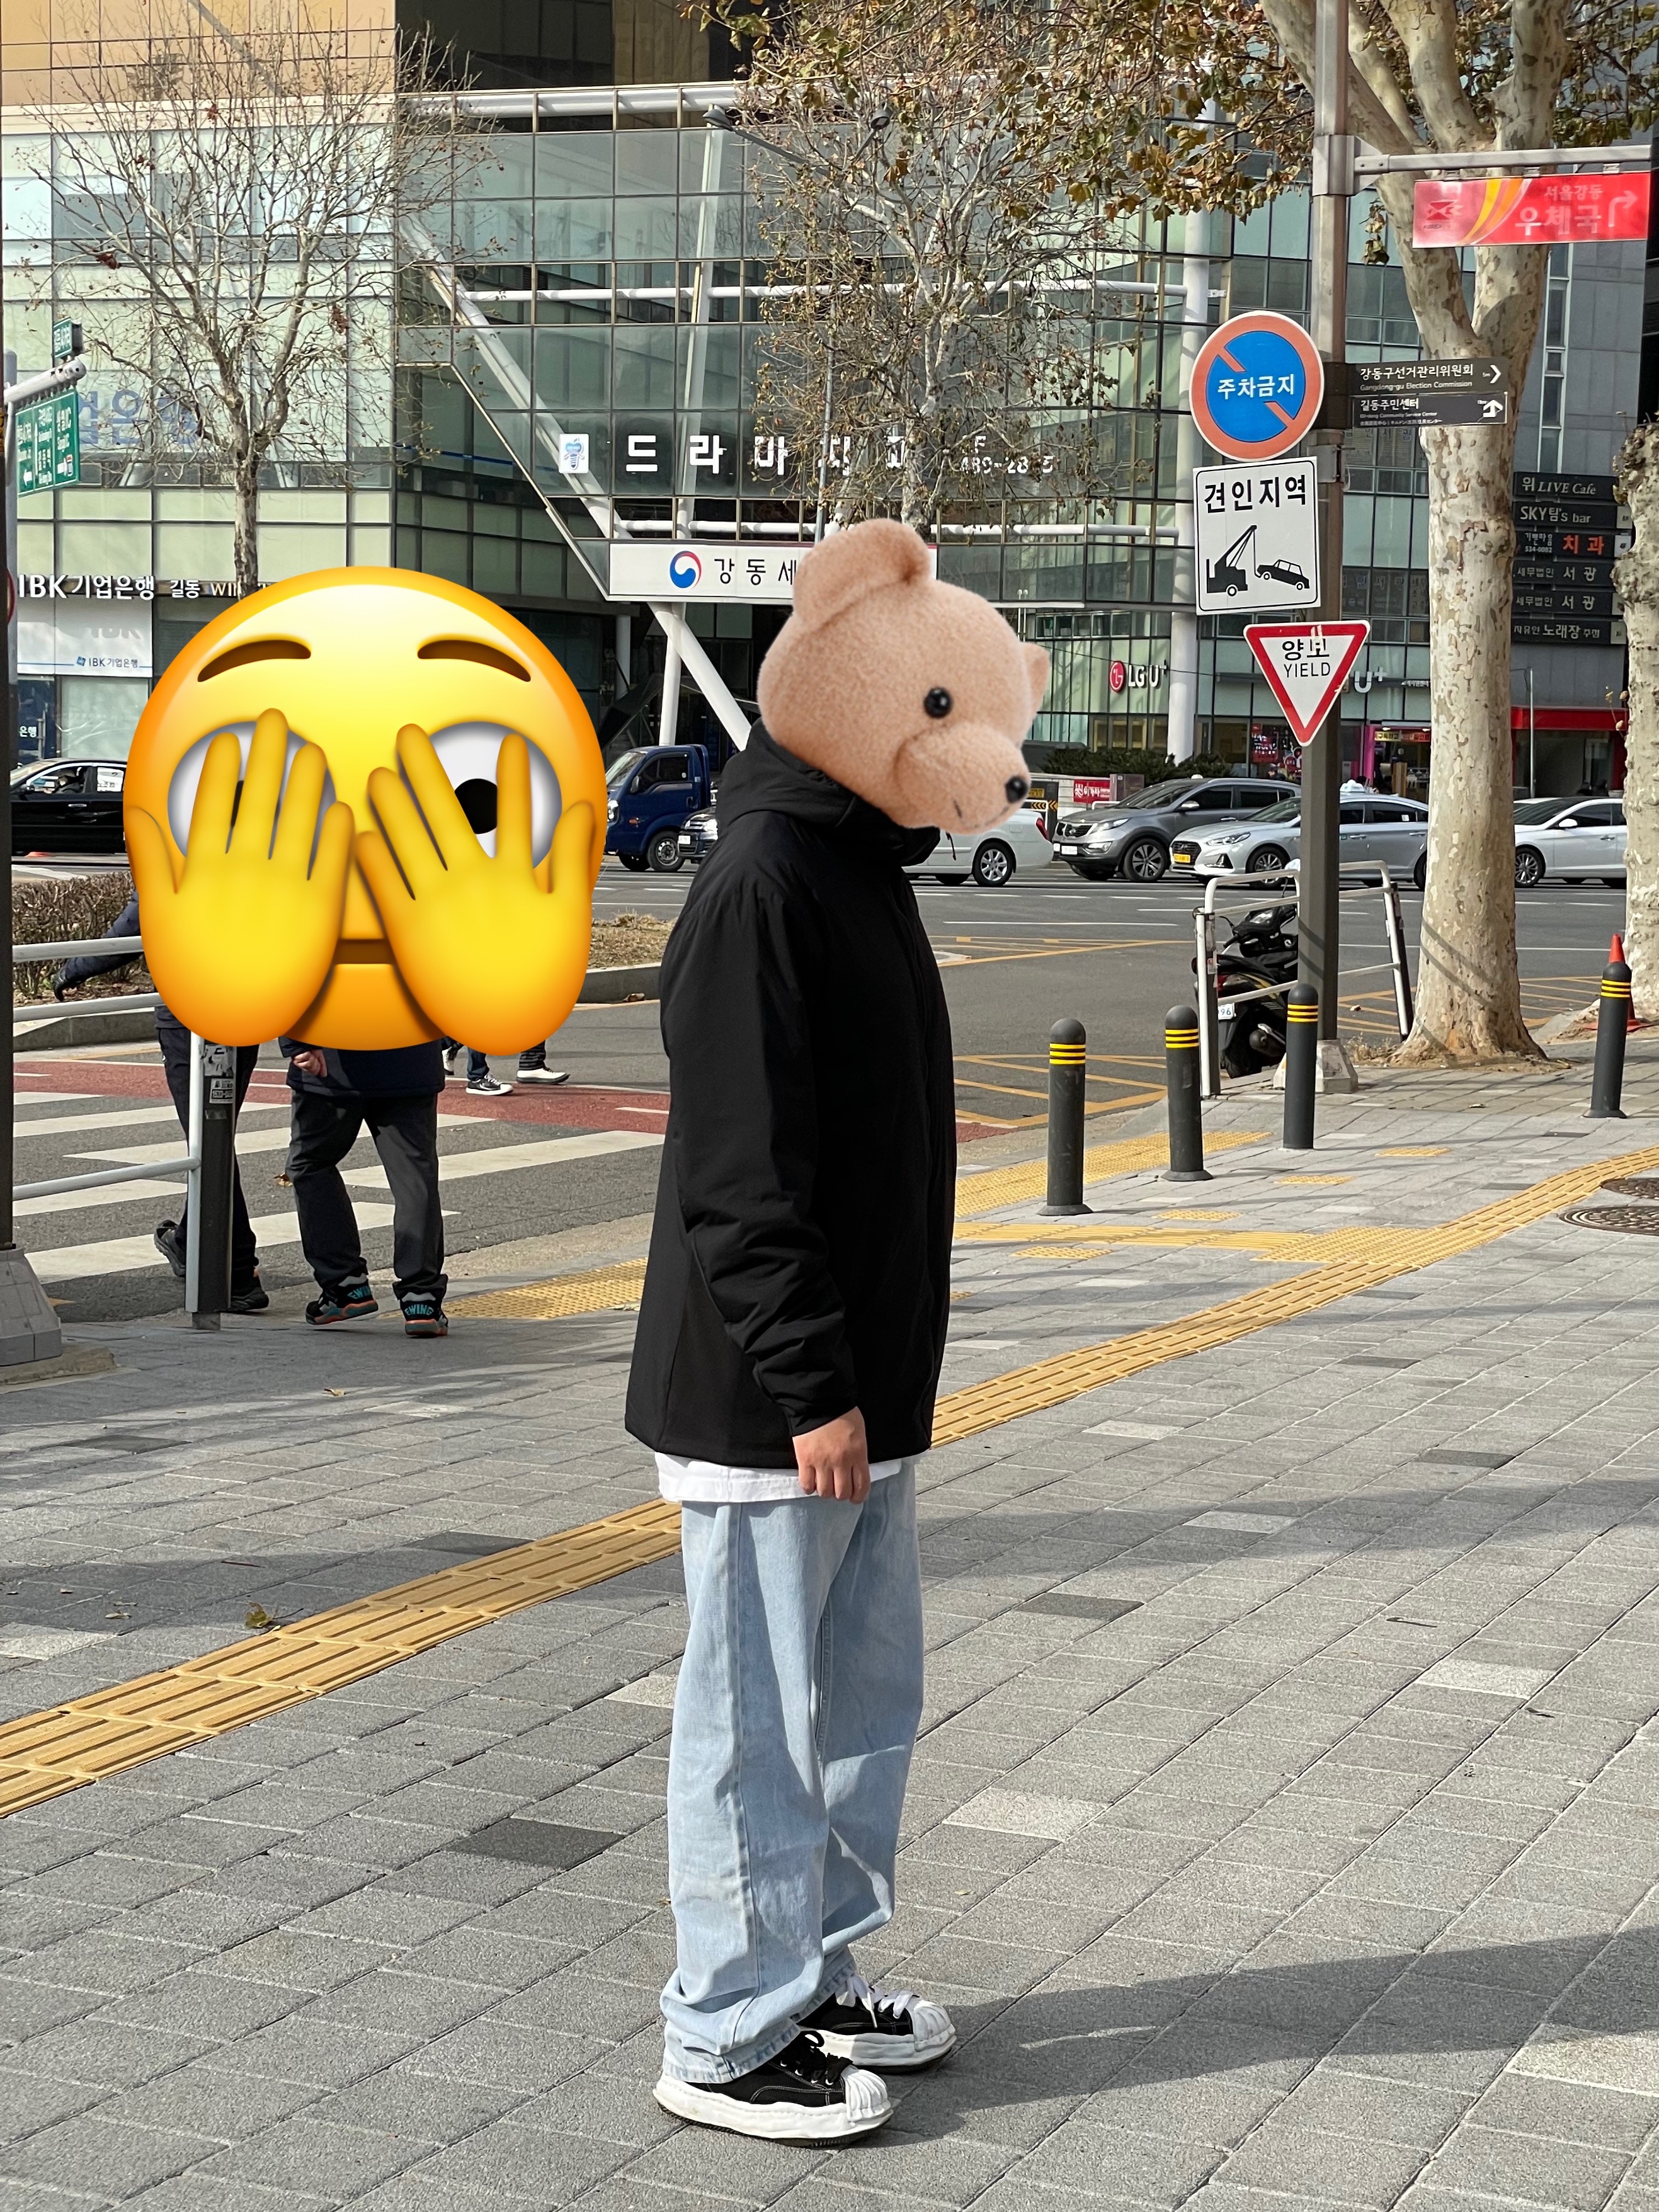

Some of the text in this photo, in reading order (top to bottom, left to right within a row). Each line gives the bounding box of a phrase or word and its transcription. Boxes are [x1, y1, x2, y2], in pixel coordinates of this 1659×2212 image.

[1544, 183, 1604, 202] 서울강동
[1515, 205, 1602, 236] 우체국
[1360, 363, 1473, 381] 강동구선거관리위원회
[1217, 373, 1294, 400] 주차금지
[1360, 384, 1405, 392] Gangdong-gu
[1360, 397, 1419, 411] 길동주민센터
[1204, 474, 1306, 513] 견인지역
[1537, 481, 1570, 494] LIVE
[1572, 482, 1596, 496] Cafe
[1572, 513, 1592, 523] bar
[1563, 534, 1605, 556] 치과
[1517, 567, 1554, 578] 세무법인
[18, 574, 69, 599] IBK
[71, 574, 156, 601] 기업은행
[169, 578, 201, 599] 길동
[1515, 596, 1553, 607] 세무법인
[1542, 624, 1581, 639] 노래장
[1282, 638, 1330, 661] 양보
[88, 657, 139, 669] IBK 기업은행
[1284, 662, 1331, 678] YIELD
[1128, 664, 1145, 687] LG
[19, 726, 37, 739] 은행
[1218, 1007, 1232, 1016] 96
[404, 1303, 435, 1316] EWING
